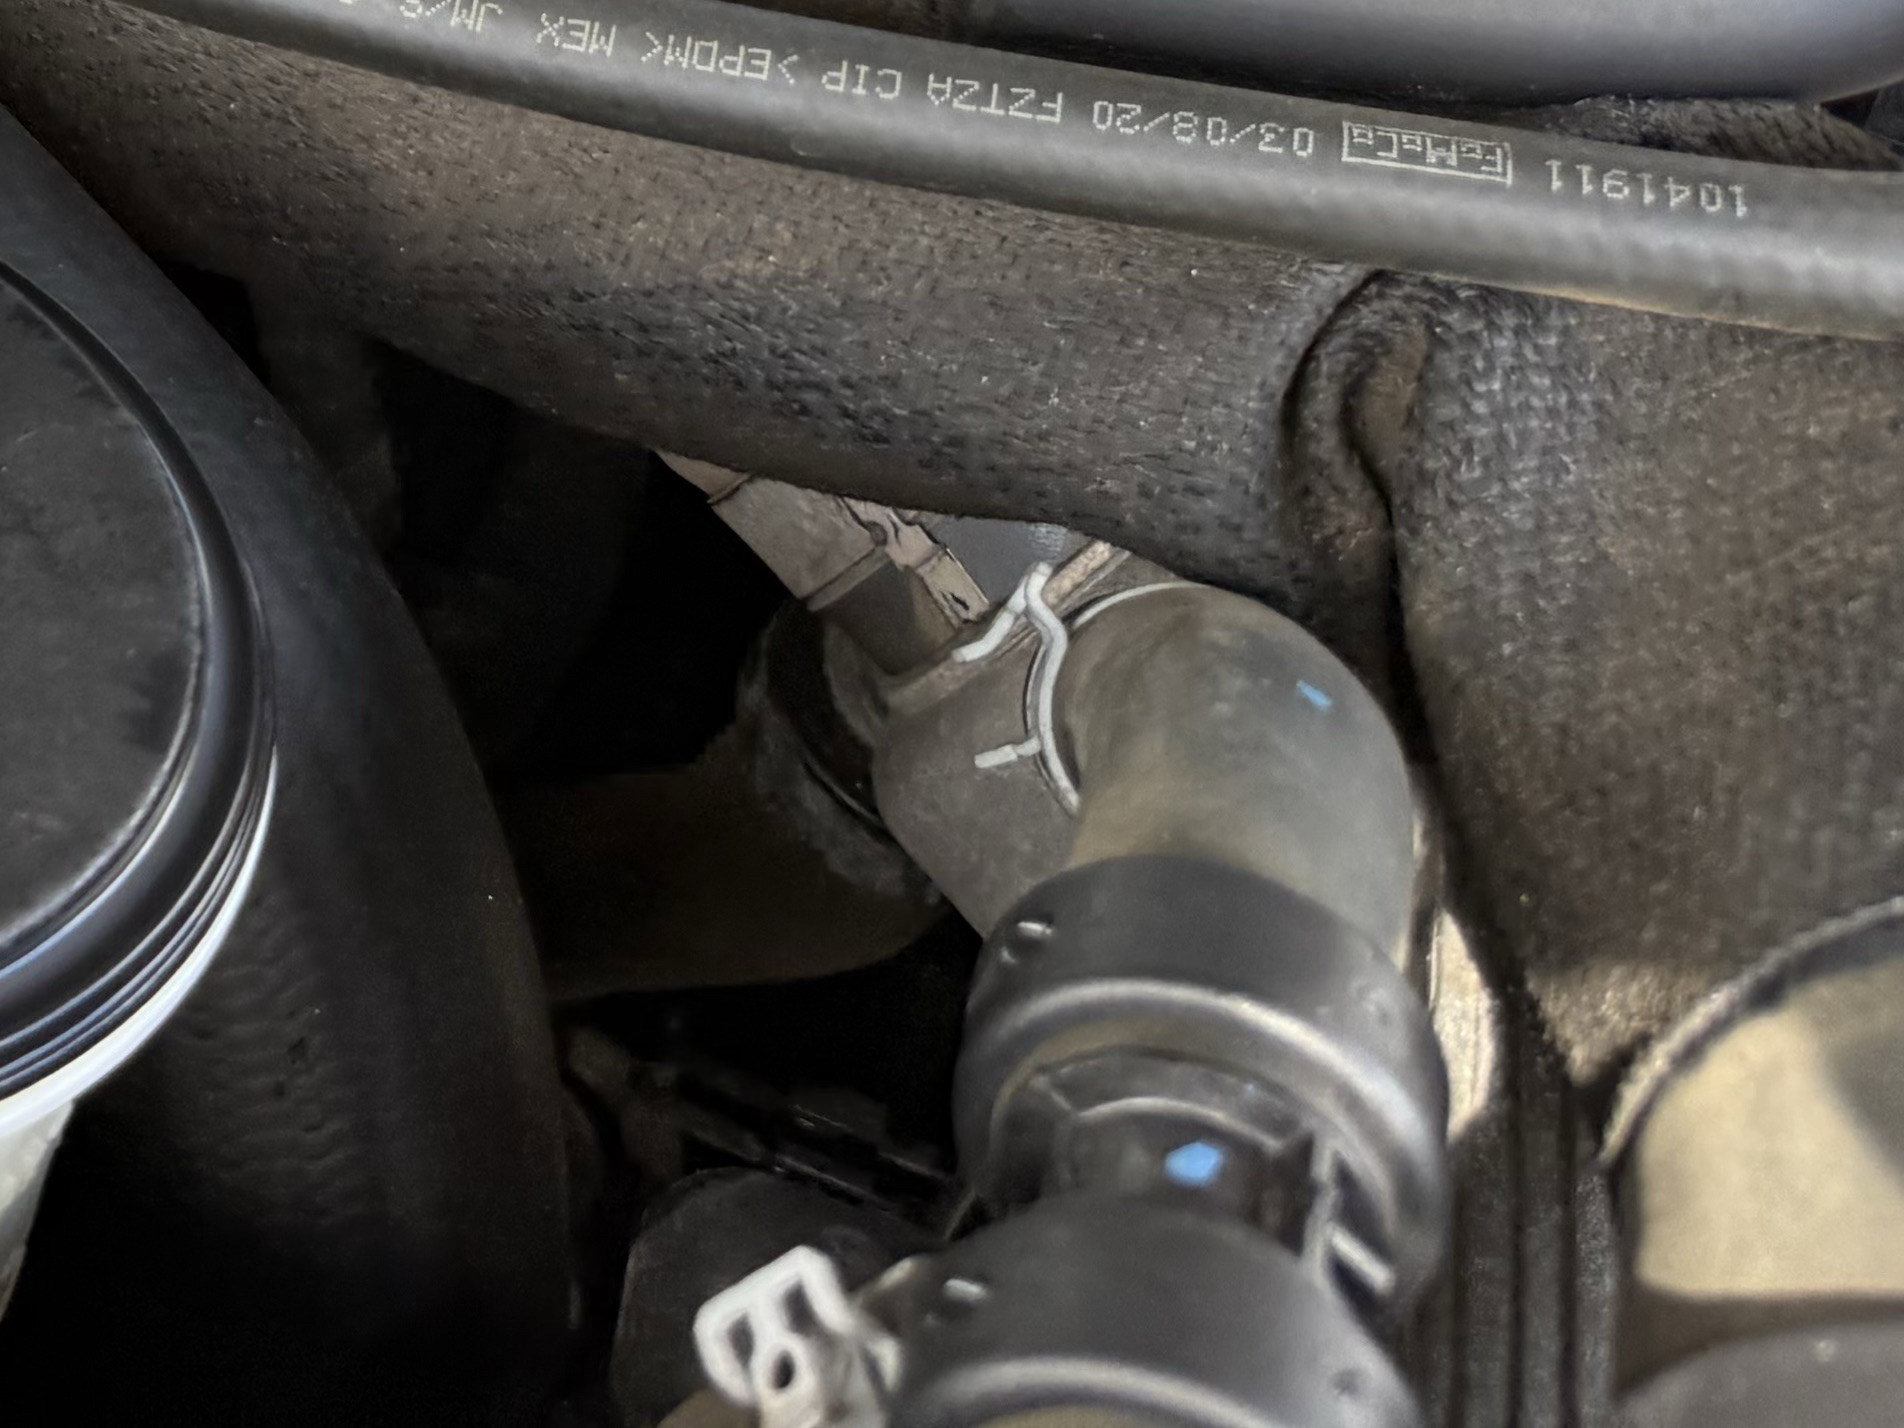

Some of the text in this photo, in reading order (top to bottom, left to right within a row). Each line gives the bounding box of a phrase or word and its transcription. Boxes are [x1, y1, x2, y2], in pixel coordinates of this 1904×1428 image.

[537, 12, 617, 58] MEX
[641, 31, 798, 86] >EPDM<
[822, 60, 902, 99] CIP
[928, 73, 1062, 123] FZTZA
[1093, 100, 1314, 157] 03/08/20
[1545, 159, 1748, 218] 1041911
